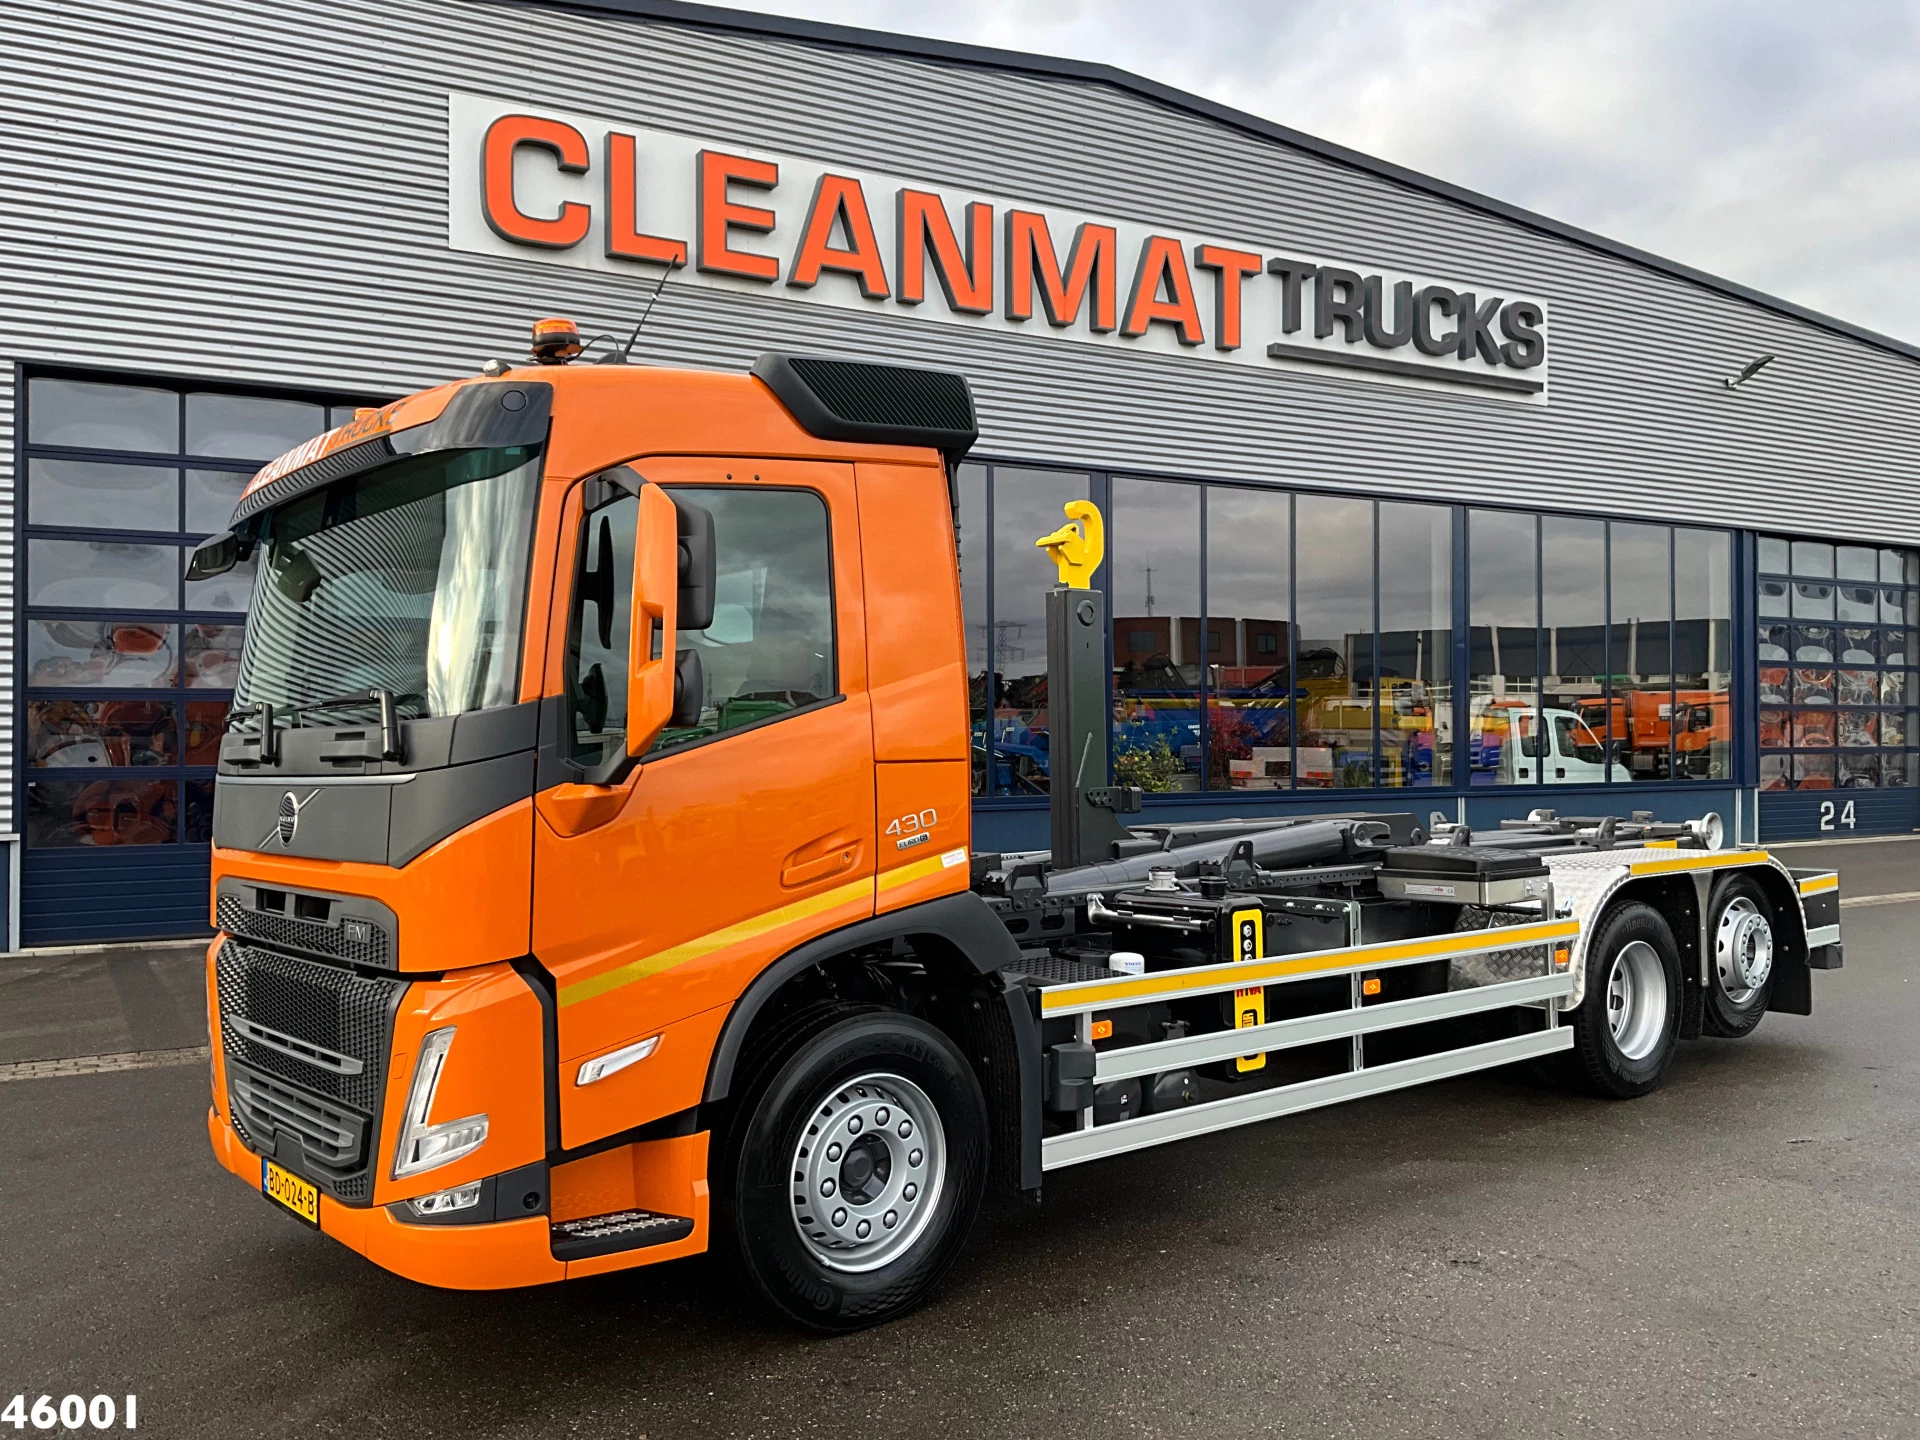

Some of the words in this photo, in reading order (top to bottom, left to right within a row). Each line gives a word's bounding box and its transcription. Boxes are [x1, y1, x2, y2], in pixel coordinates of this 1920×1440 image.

[480, 113, 1263, 352] CLEANMAT
[1267, 257, 1544, 369] TRUCKS
[885, 808, 937, 836] 430
[1820, 800, 1856, 830] 24
[347, 924, 366, 942] FM
[269, 1167, 315, 1216] BD-024-B
